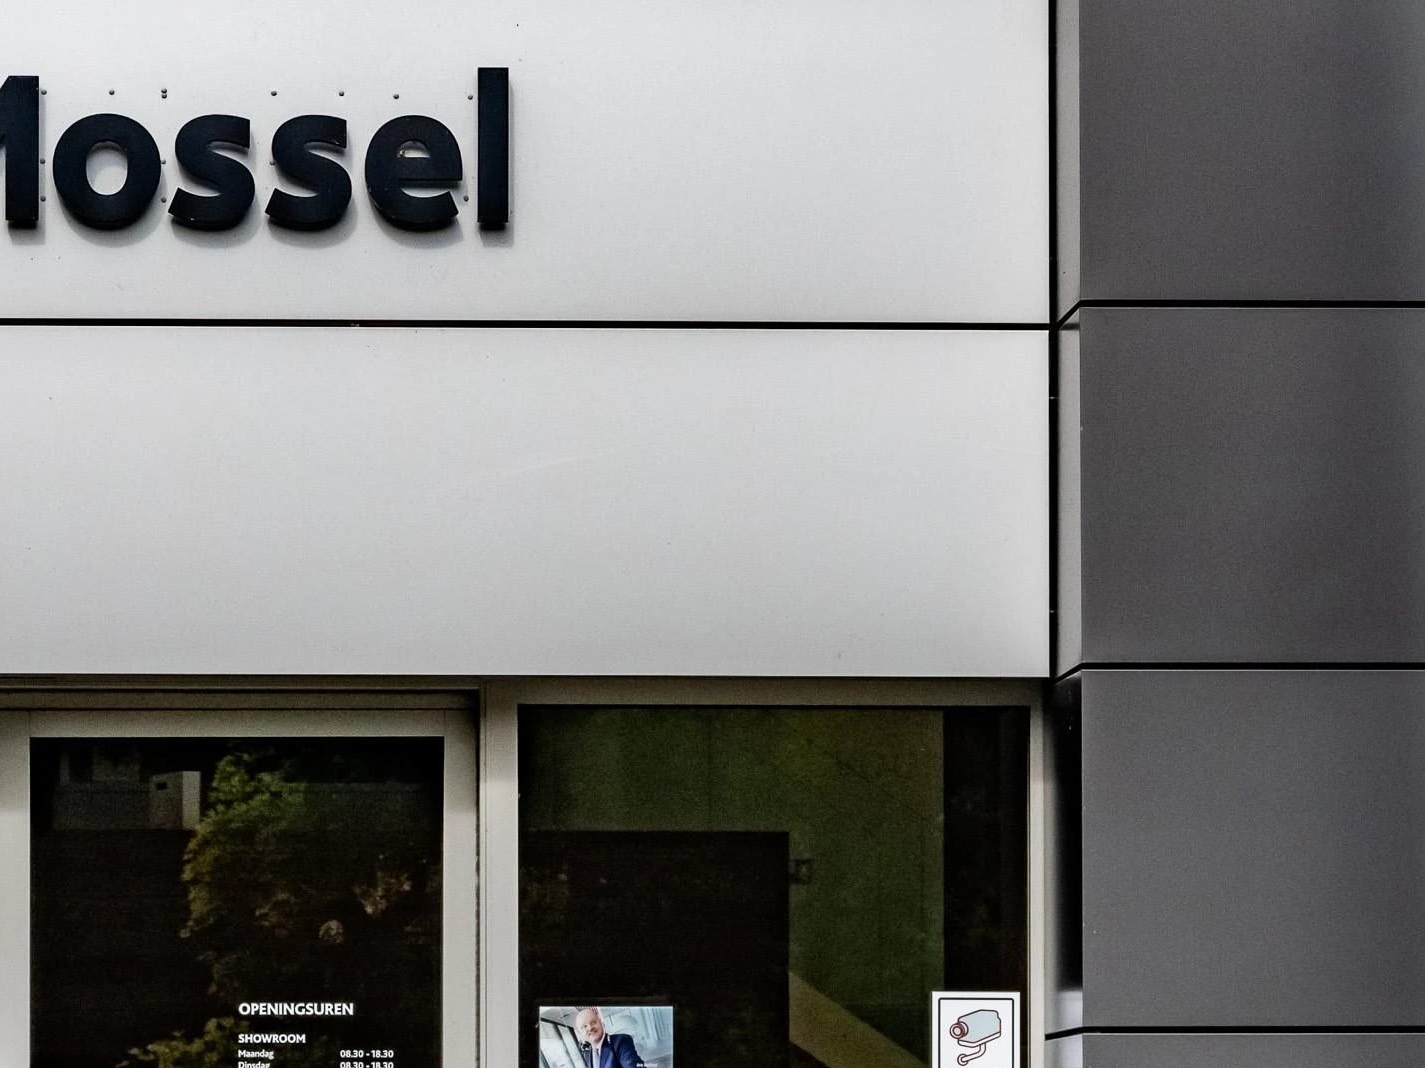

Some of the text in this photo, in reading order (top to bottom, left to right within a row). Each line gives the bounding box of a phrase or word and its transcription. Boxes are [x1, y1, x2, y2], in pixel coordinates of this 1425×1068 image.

[238, 1002, 354, 1016] OPENINGSUREN
[237, 1033, 306, 1044] SHOWROOM
[237, 1049, 275, 1060] Maandag
[339, 1049, 365, 1059] 08.30
[370, 1049, 395, 1059] 18.30
